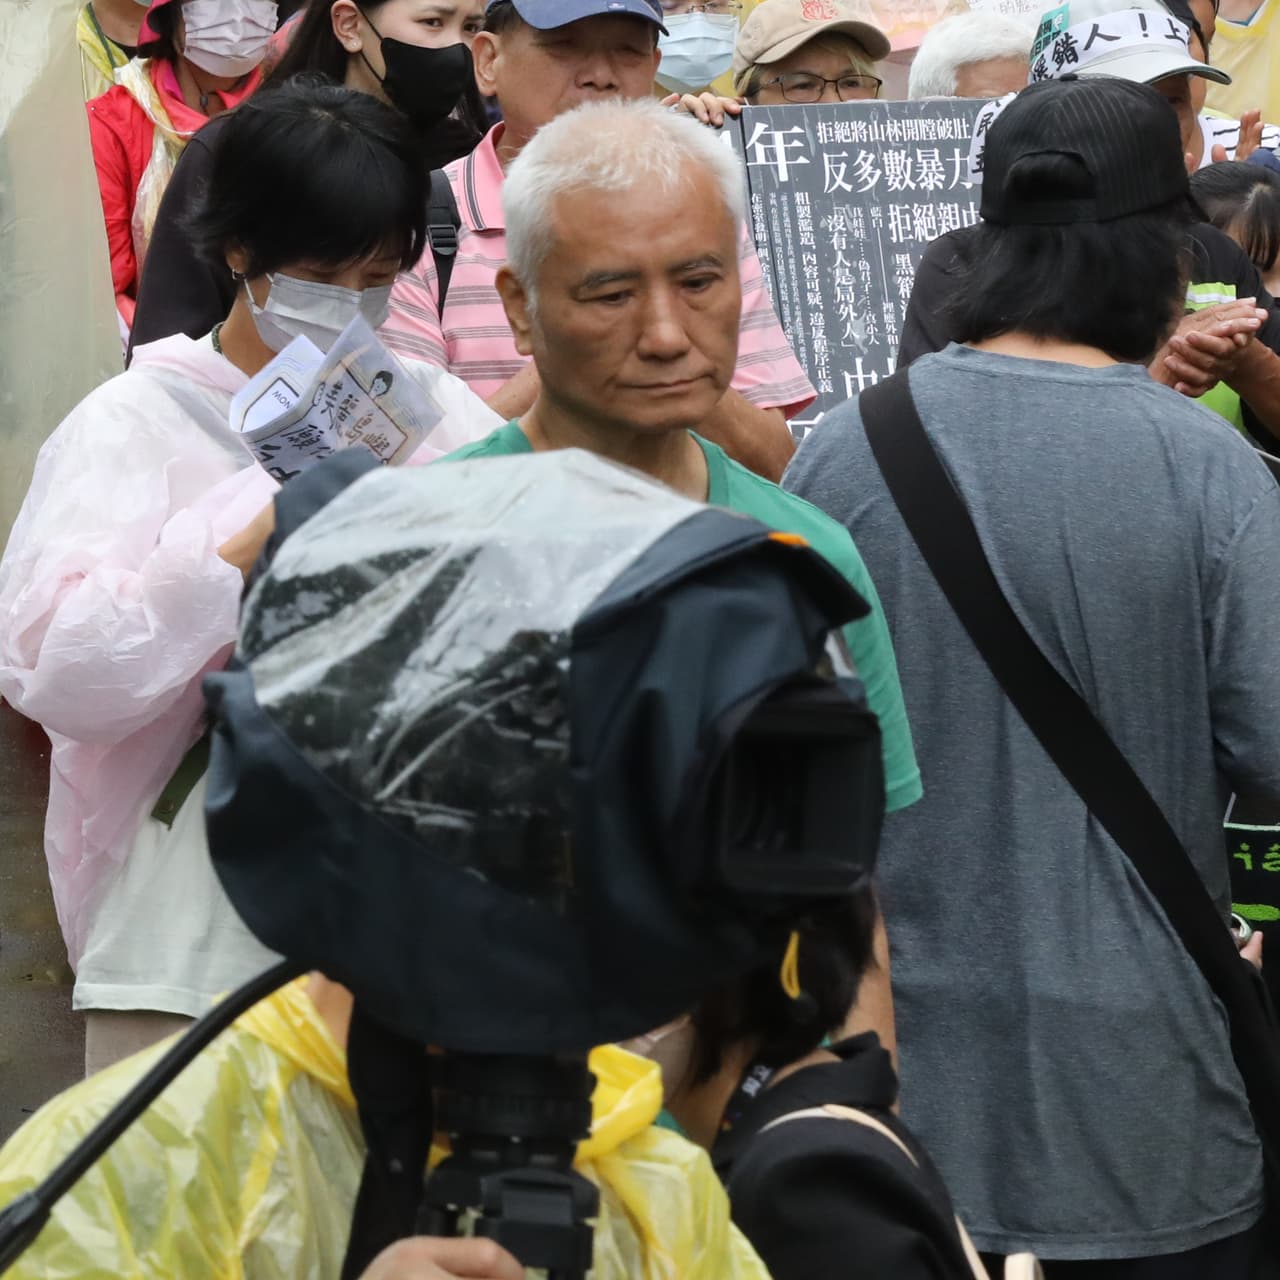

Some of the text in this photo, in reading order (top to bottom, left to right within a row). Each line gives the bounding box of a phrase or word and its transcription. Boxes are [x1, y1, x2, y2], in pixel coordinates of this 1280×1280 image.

[816, 117, 972, 145] 拒絕將山林開膛破肚
[823, 147, 973, 193] 反多數暴力
